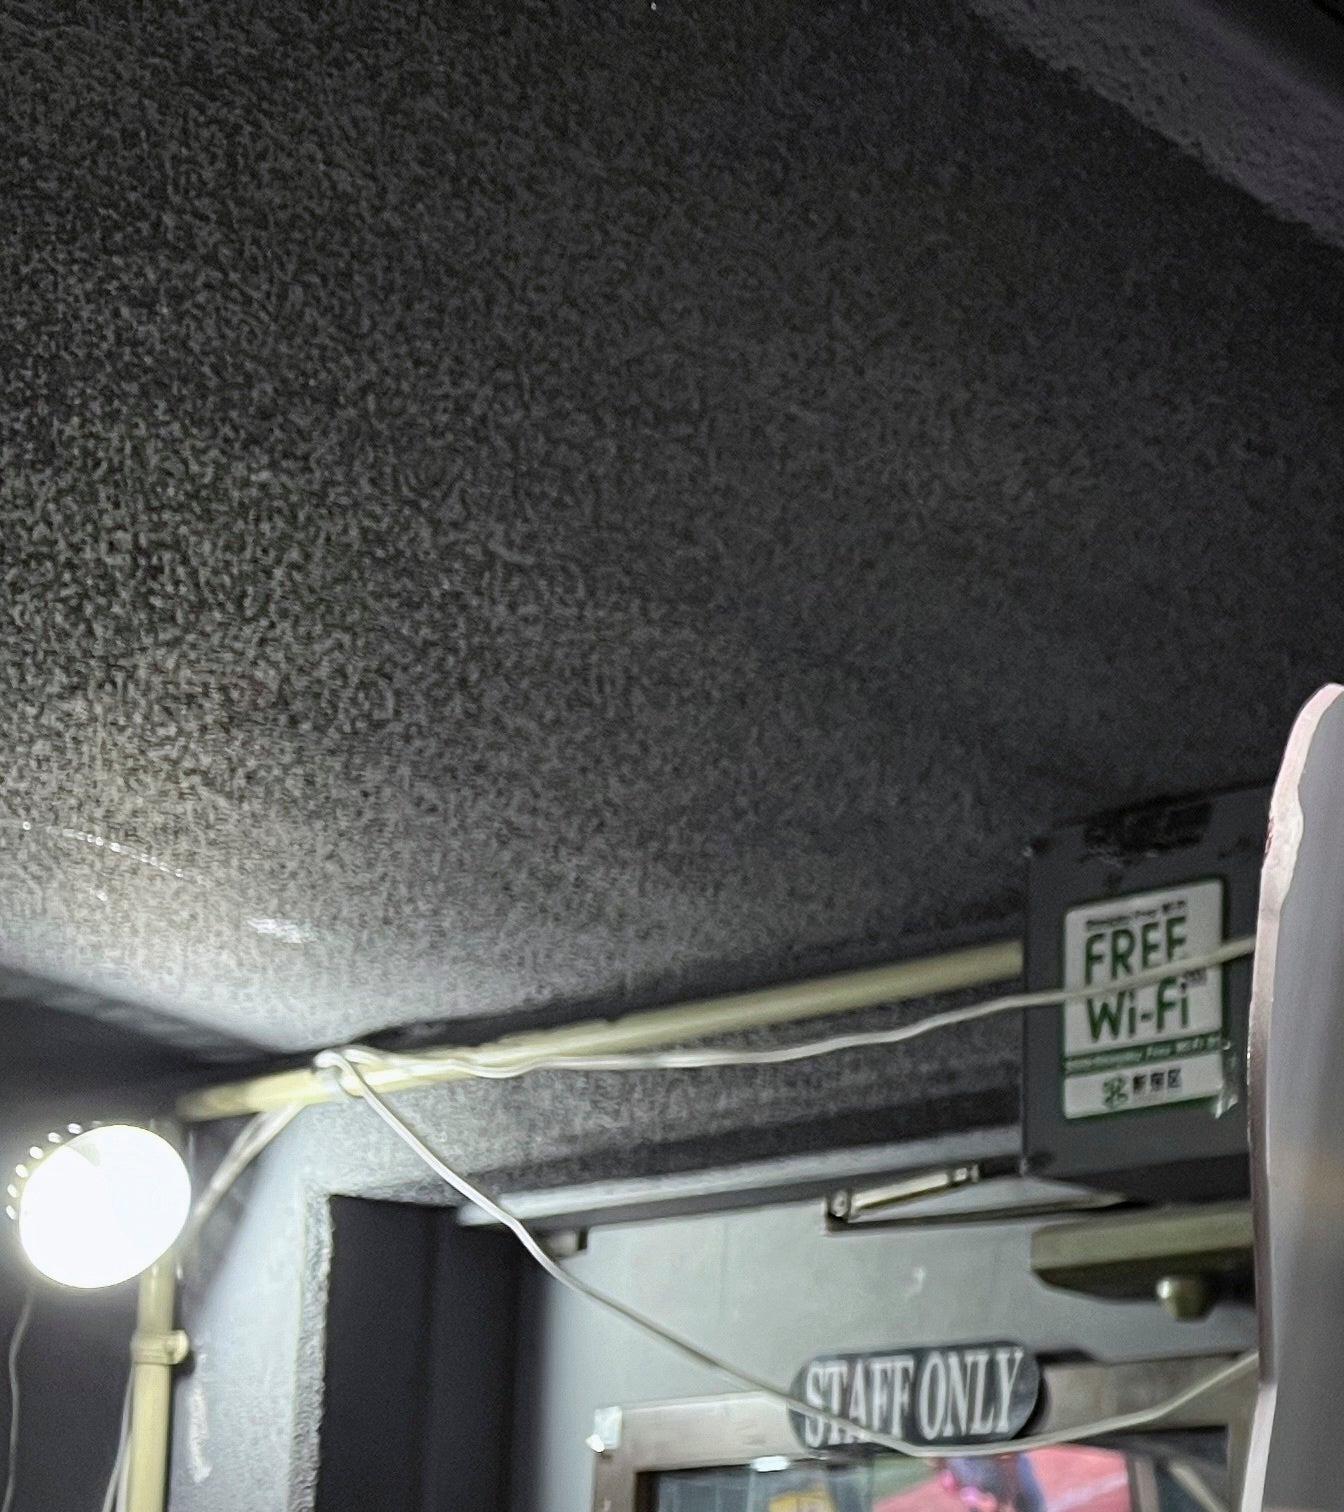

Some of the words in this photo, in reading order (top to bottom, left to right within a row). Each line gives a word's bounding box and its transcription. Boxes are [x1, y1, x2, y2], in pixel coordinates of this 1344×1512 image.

[1084, 915, 1188, 986] FREE
[1086, 975, 1189, 1043] Wi-Fi
[804, 1356, 914, 1448] STAFF
[918, 1347, 1024, 1441] ONLY
